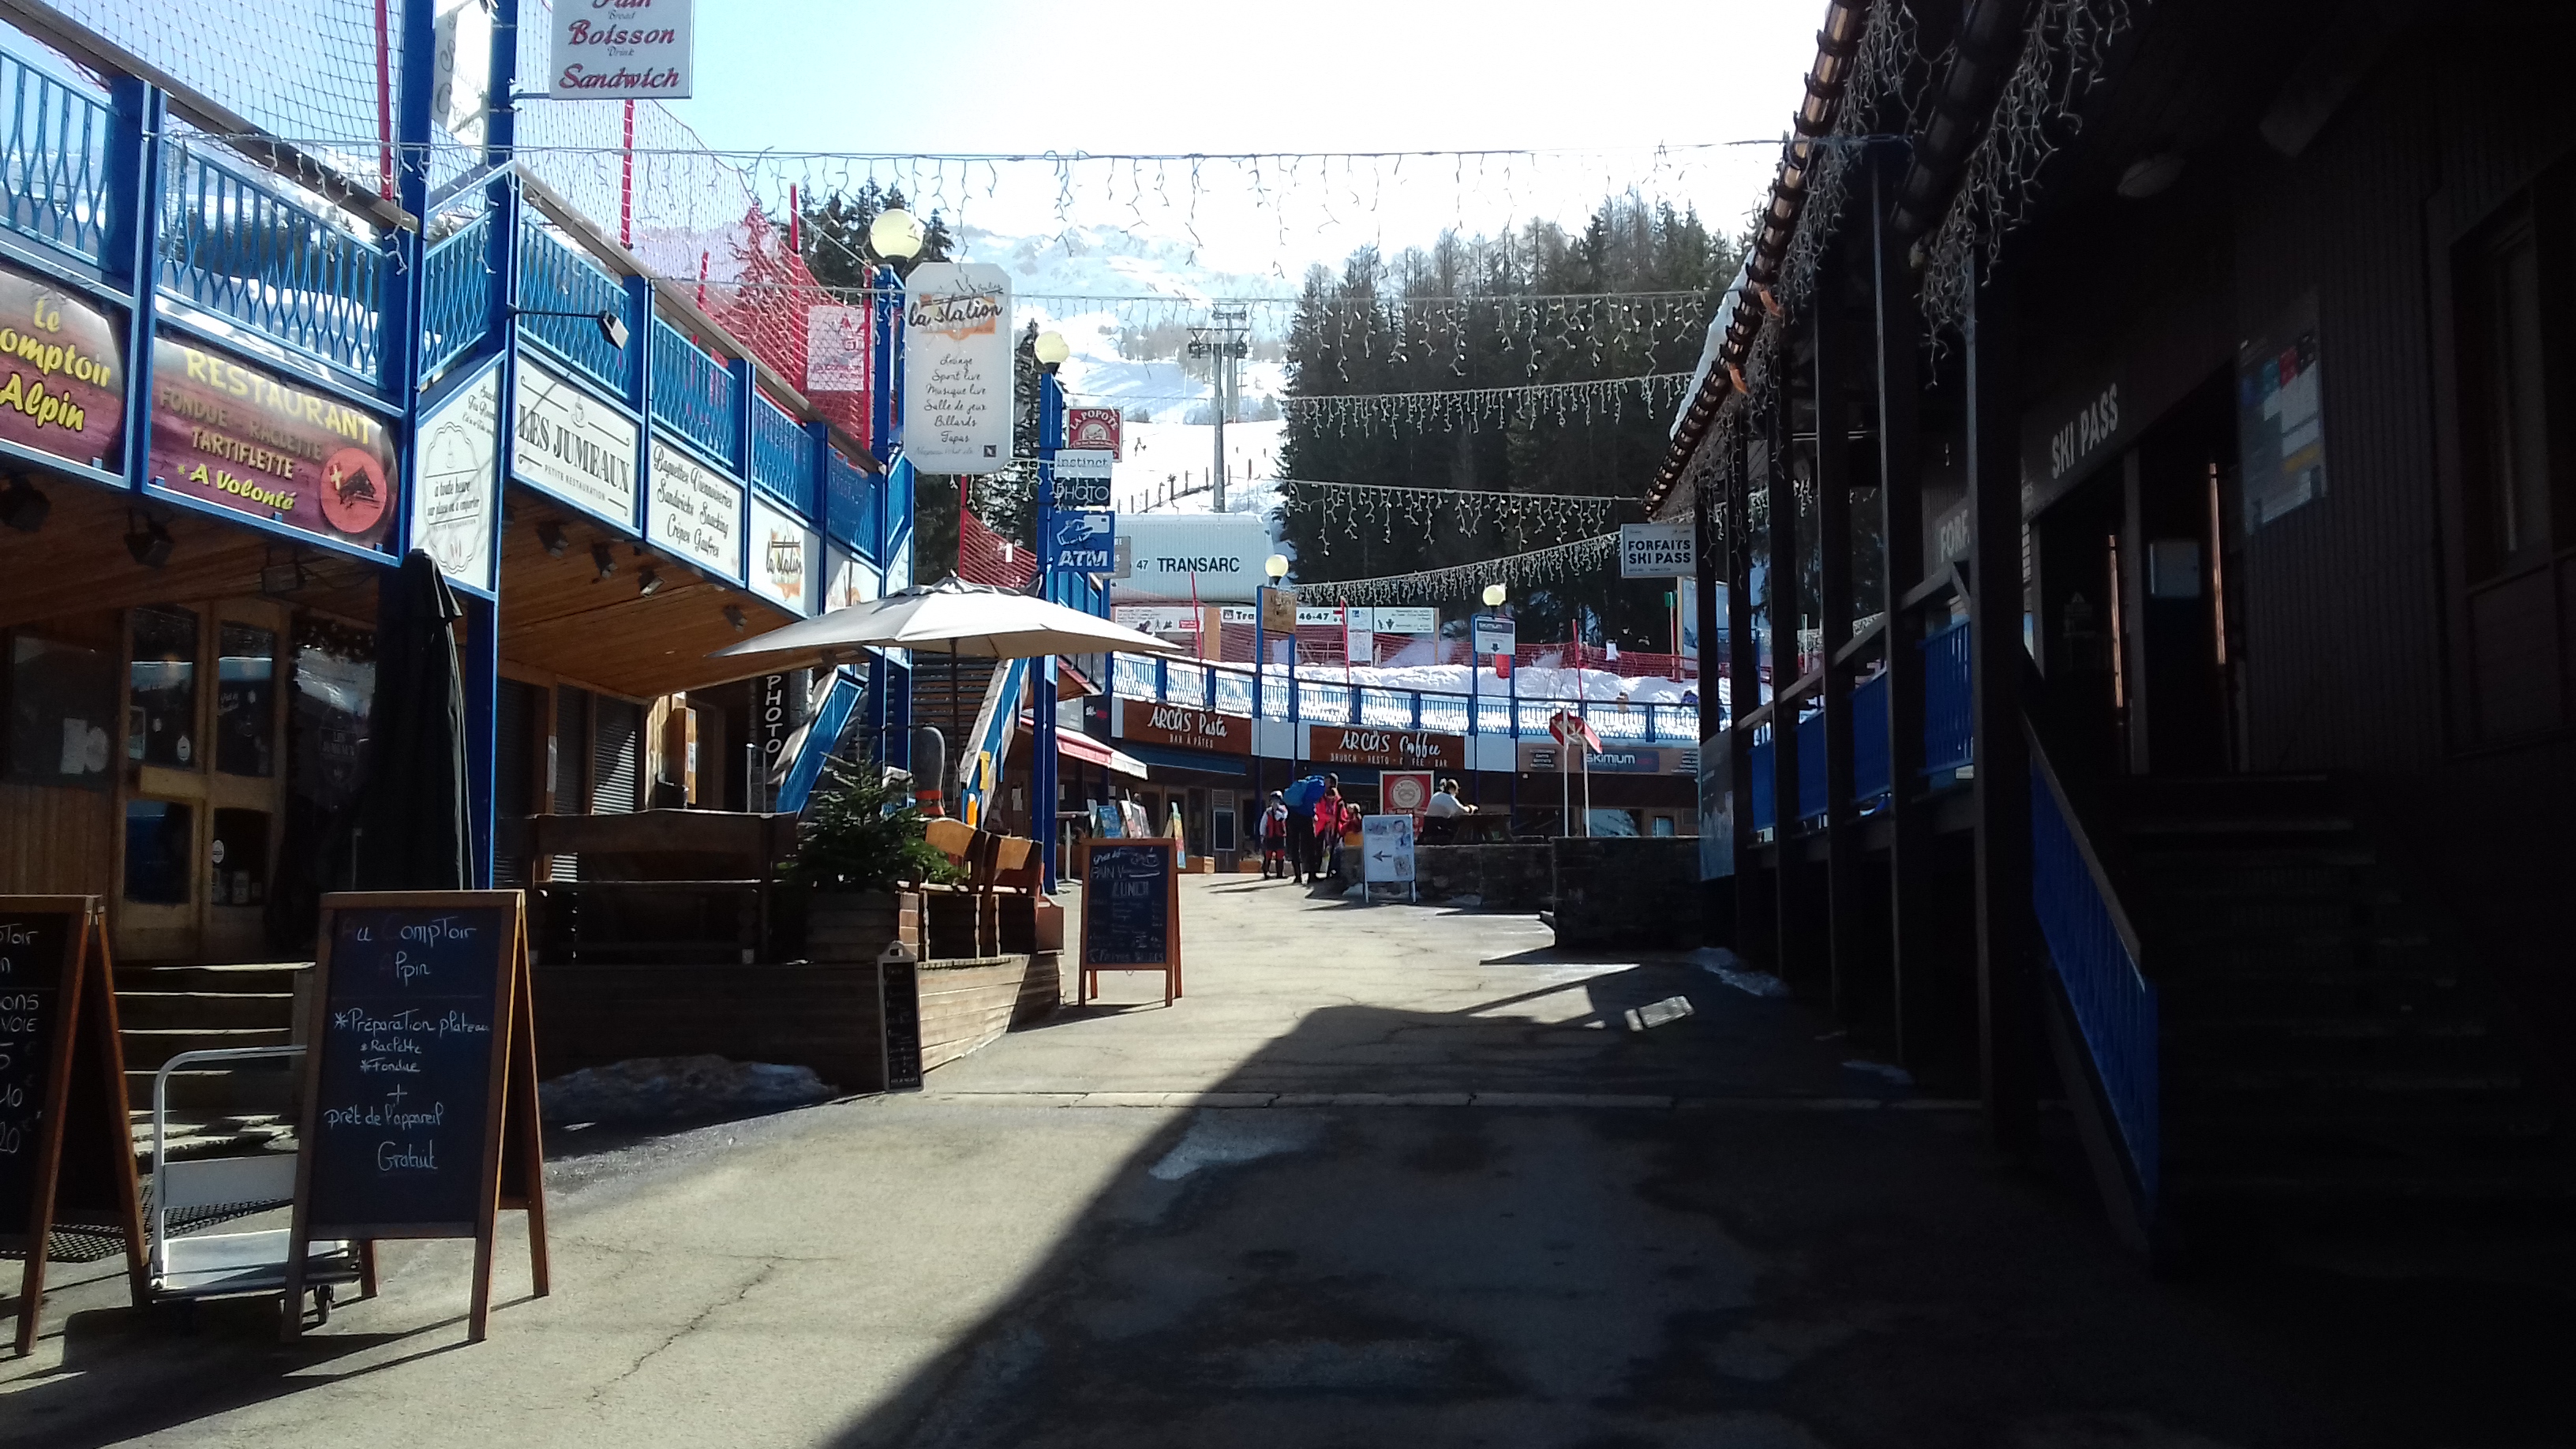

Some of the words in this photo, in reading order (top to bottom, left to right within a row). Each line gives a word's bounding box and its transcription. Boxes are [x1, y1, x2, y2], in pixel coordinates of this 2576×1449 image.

[592, 0, 652, 9] ain
[567, 19, 676, 46] Boisson
[607, 46, 635, 57] Drink
[558, 63, 680, 89] Sandwich
[33, 299, 60, 331] Le
[931, 369, 960, 384] Sport
[184, 348, 372, 445] RESTAURANT
[926, 383, 967, 399] Musique
[0, 373, 85, 431] Alpin
[159, 390, 229, 429] FONDUE
[249, 420, 325, 460] RACLETTE
[934, 415, 977, 427] Billards
[1069, 417, 1083, 430] LA
[1080, 409, 1119, 431] POPOTE
[941, 431, 969, 444] Tapas
[2051, 421, 2076, 480] SKI
[2080, 382, 2119, 458] PASS
[191, 427, 296, 480] TARTIFLETTE
[518, 403, 550, 452] LES
[553, 424, 630, 495] JUMEAUX
[1057, 457, 1108, 468] instinct
[216, 470, 298, 511] Volonté
[545, 464, 564, 481] PETITE
[566, 474, 606, 501] RESTAURATION
[1056, 485, 1110, 501] PHOTO
[1627, 540, 1691, 552] FORFAITS
[1057, 550, 1109, 567] ATM
[1136, 560, 1149, 571] 47
[1156, 556, 1241, 573] TRANSARC
[1629, 552, 1652, 564] SKI
[1655, 552, 1691, 564] PASS
[1235, 611, 1255, 621] Tra
[1298, 612, 1330, 621] 46-47
[764, 674, 784, 754] PHOTO
[1199, 713, 1228, 737] Pasta
[1398, 732, 1442, 758] Coffee
[1330, 752, 1357, 764] BRUNCH
[1367, 754, 1390, 766] RESTO
[1398, 756, 1425, 768] CFEE
[371, 1039, 423, 1055] Raclette
[369, 1057, 421, 1073] Fondue
[365, 1108, 382, 1126] de
[377, 1139, 439, 1172] Gratuit
